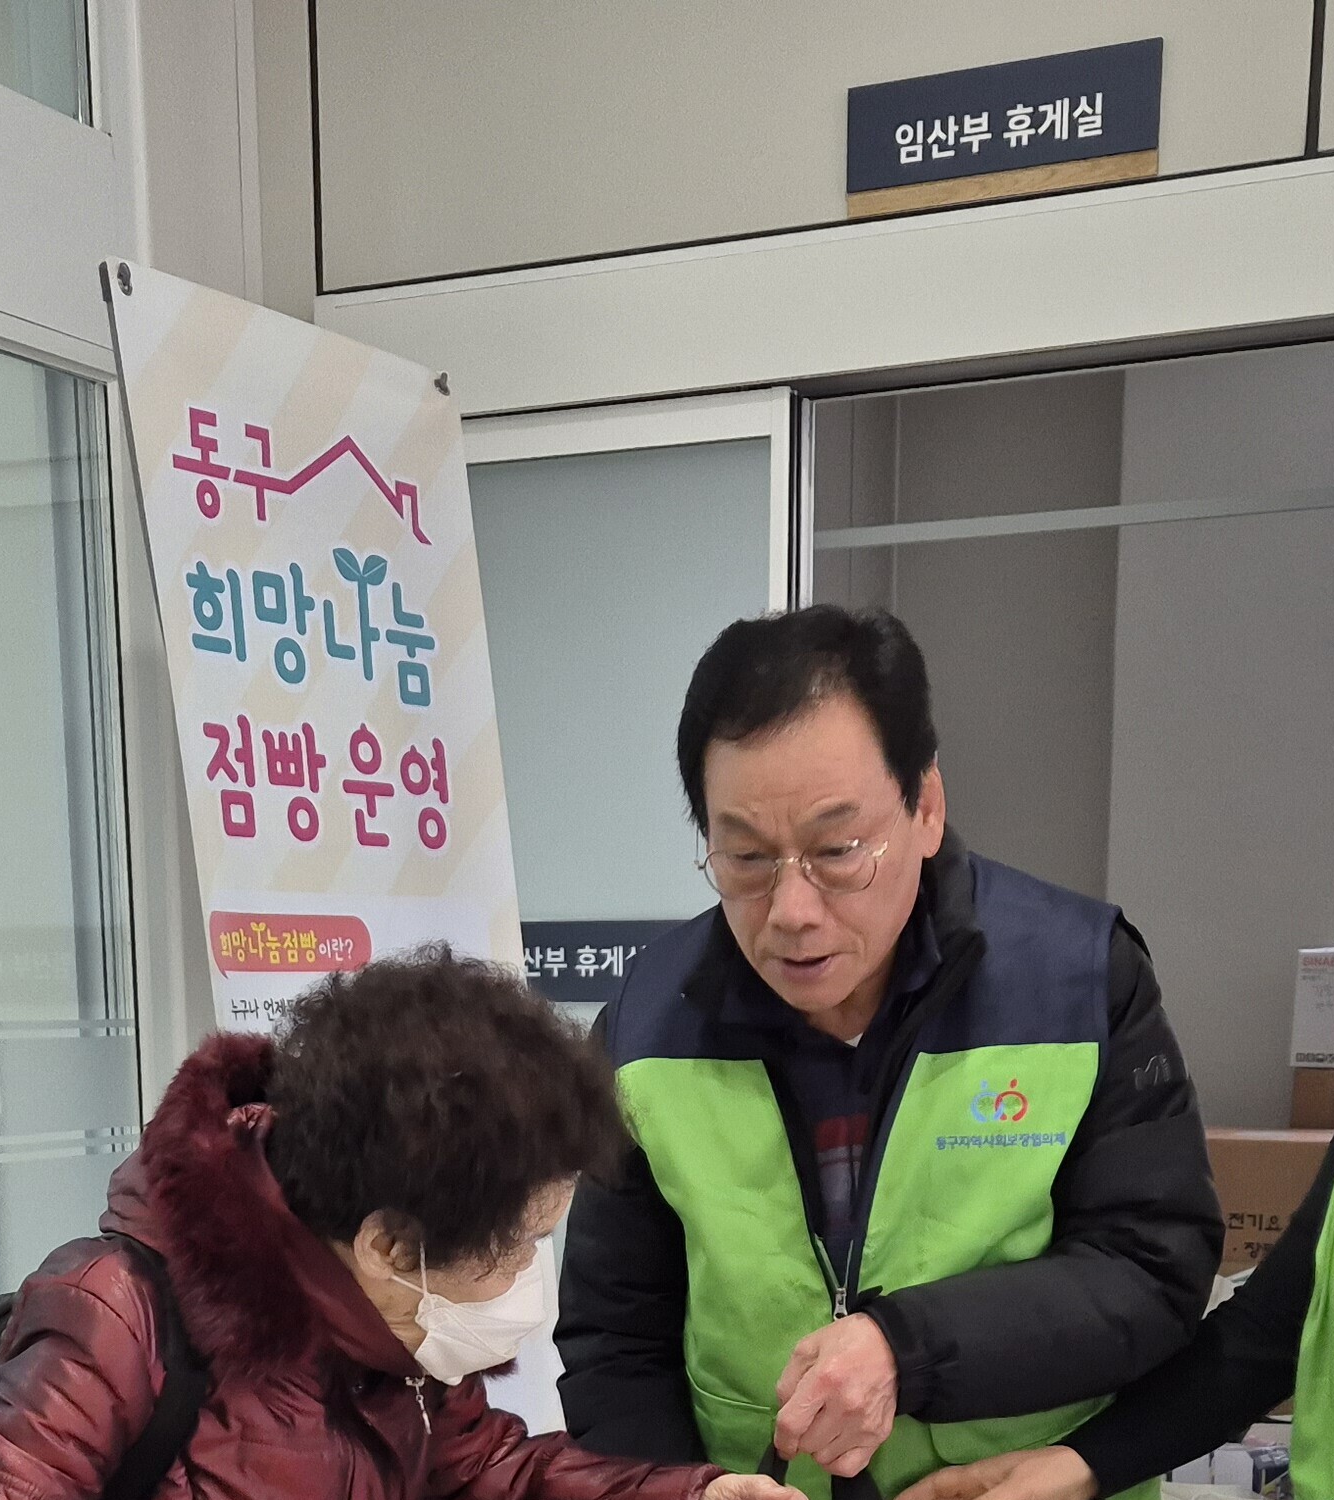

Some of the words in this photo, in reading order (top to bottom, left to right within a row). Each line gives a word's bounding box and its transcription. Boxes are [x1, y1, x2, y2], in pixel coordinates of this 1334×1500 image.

[895, 111, 993, 165] 임산부
[1003, 92, 1104, 148] 휴게실
[185, 547, 436, 707] 희망나눔
[202, 714, 327, 843] 점빵
[342, 723, 450, 850] 운영
[219, 922, 354, 964] 희망나눔점빵이란?
[231, 998, 259, 1021] 누구나
